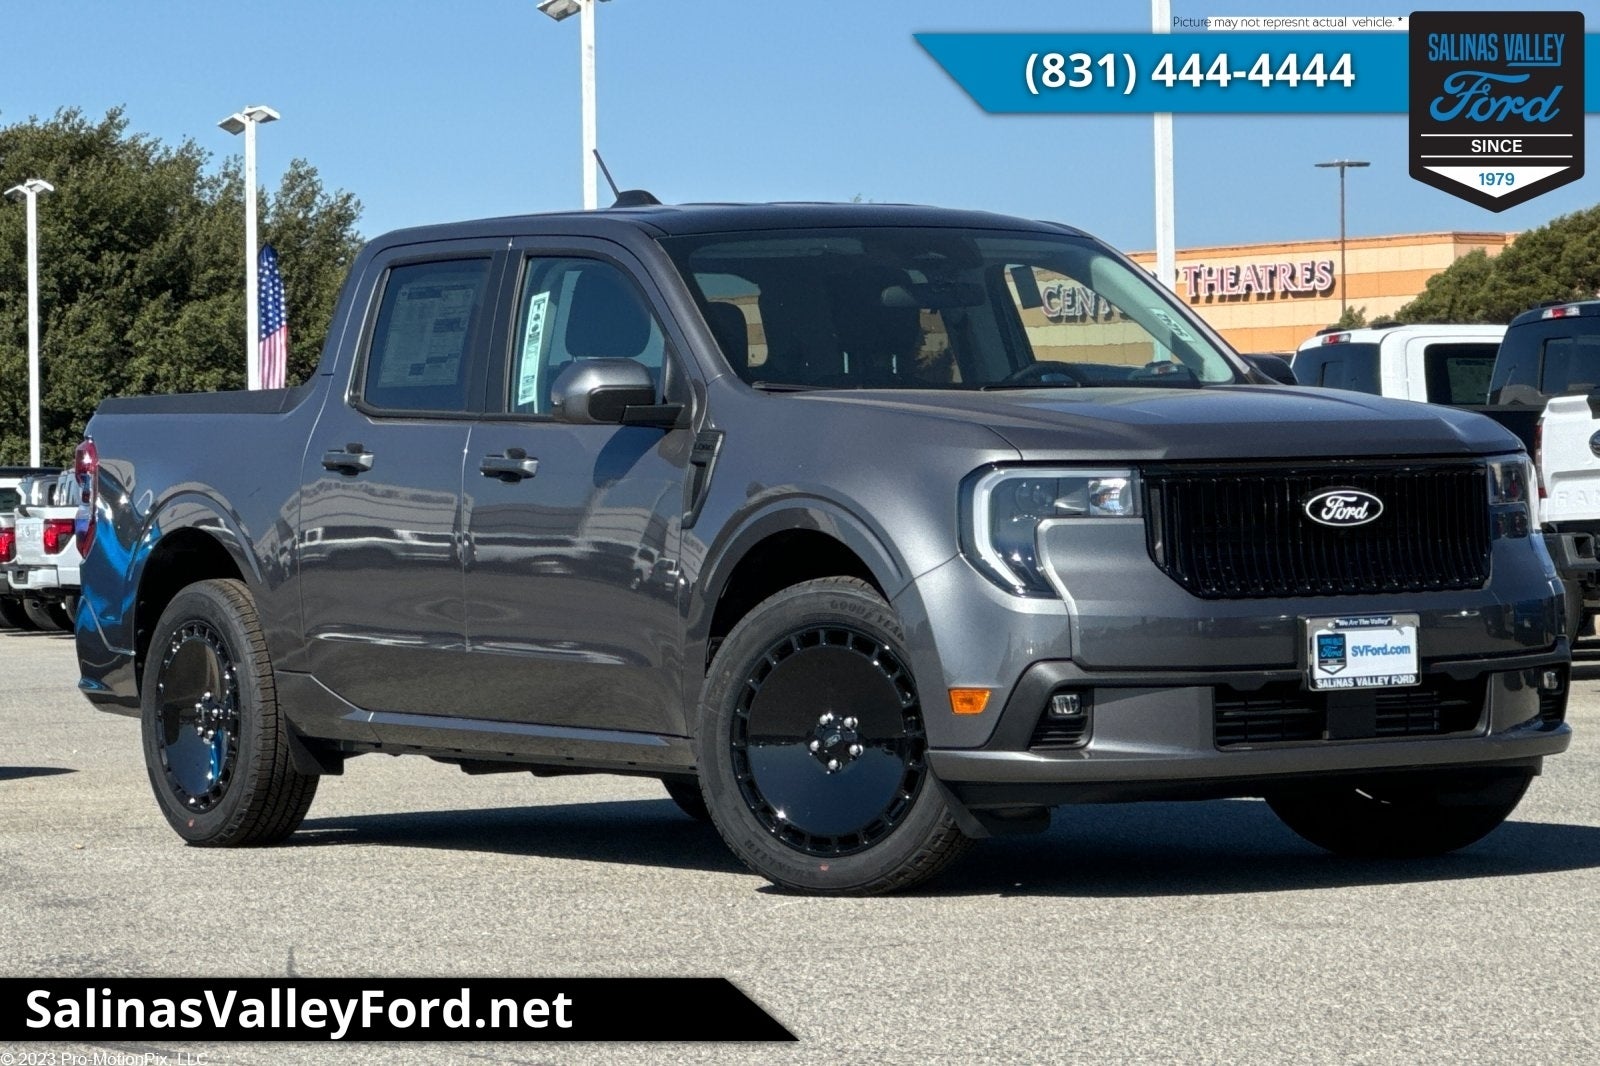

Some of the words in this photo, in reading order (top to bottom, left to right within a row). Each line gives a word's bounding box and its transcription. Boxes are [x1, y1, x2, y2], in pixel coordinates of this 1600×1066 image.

[1182, 261, 1333, 298] THEATRES
[1321, 495, 1370, 520] Ford
[1351, 644, 1411, 658] SVFord.com
[1316, 677, 1355, 689] SALINAS
[1356, 675, 1390, 687] VALLEY
[1391, 674, 1417, 685] FORD
